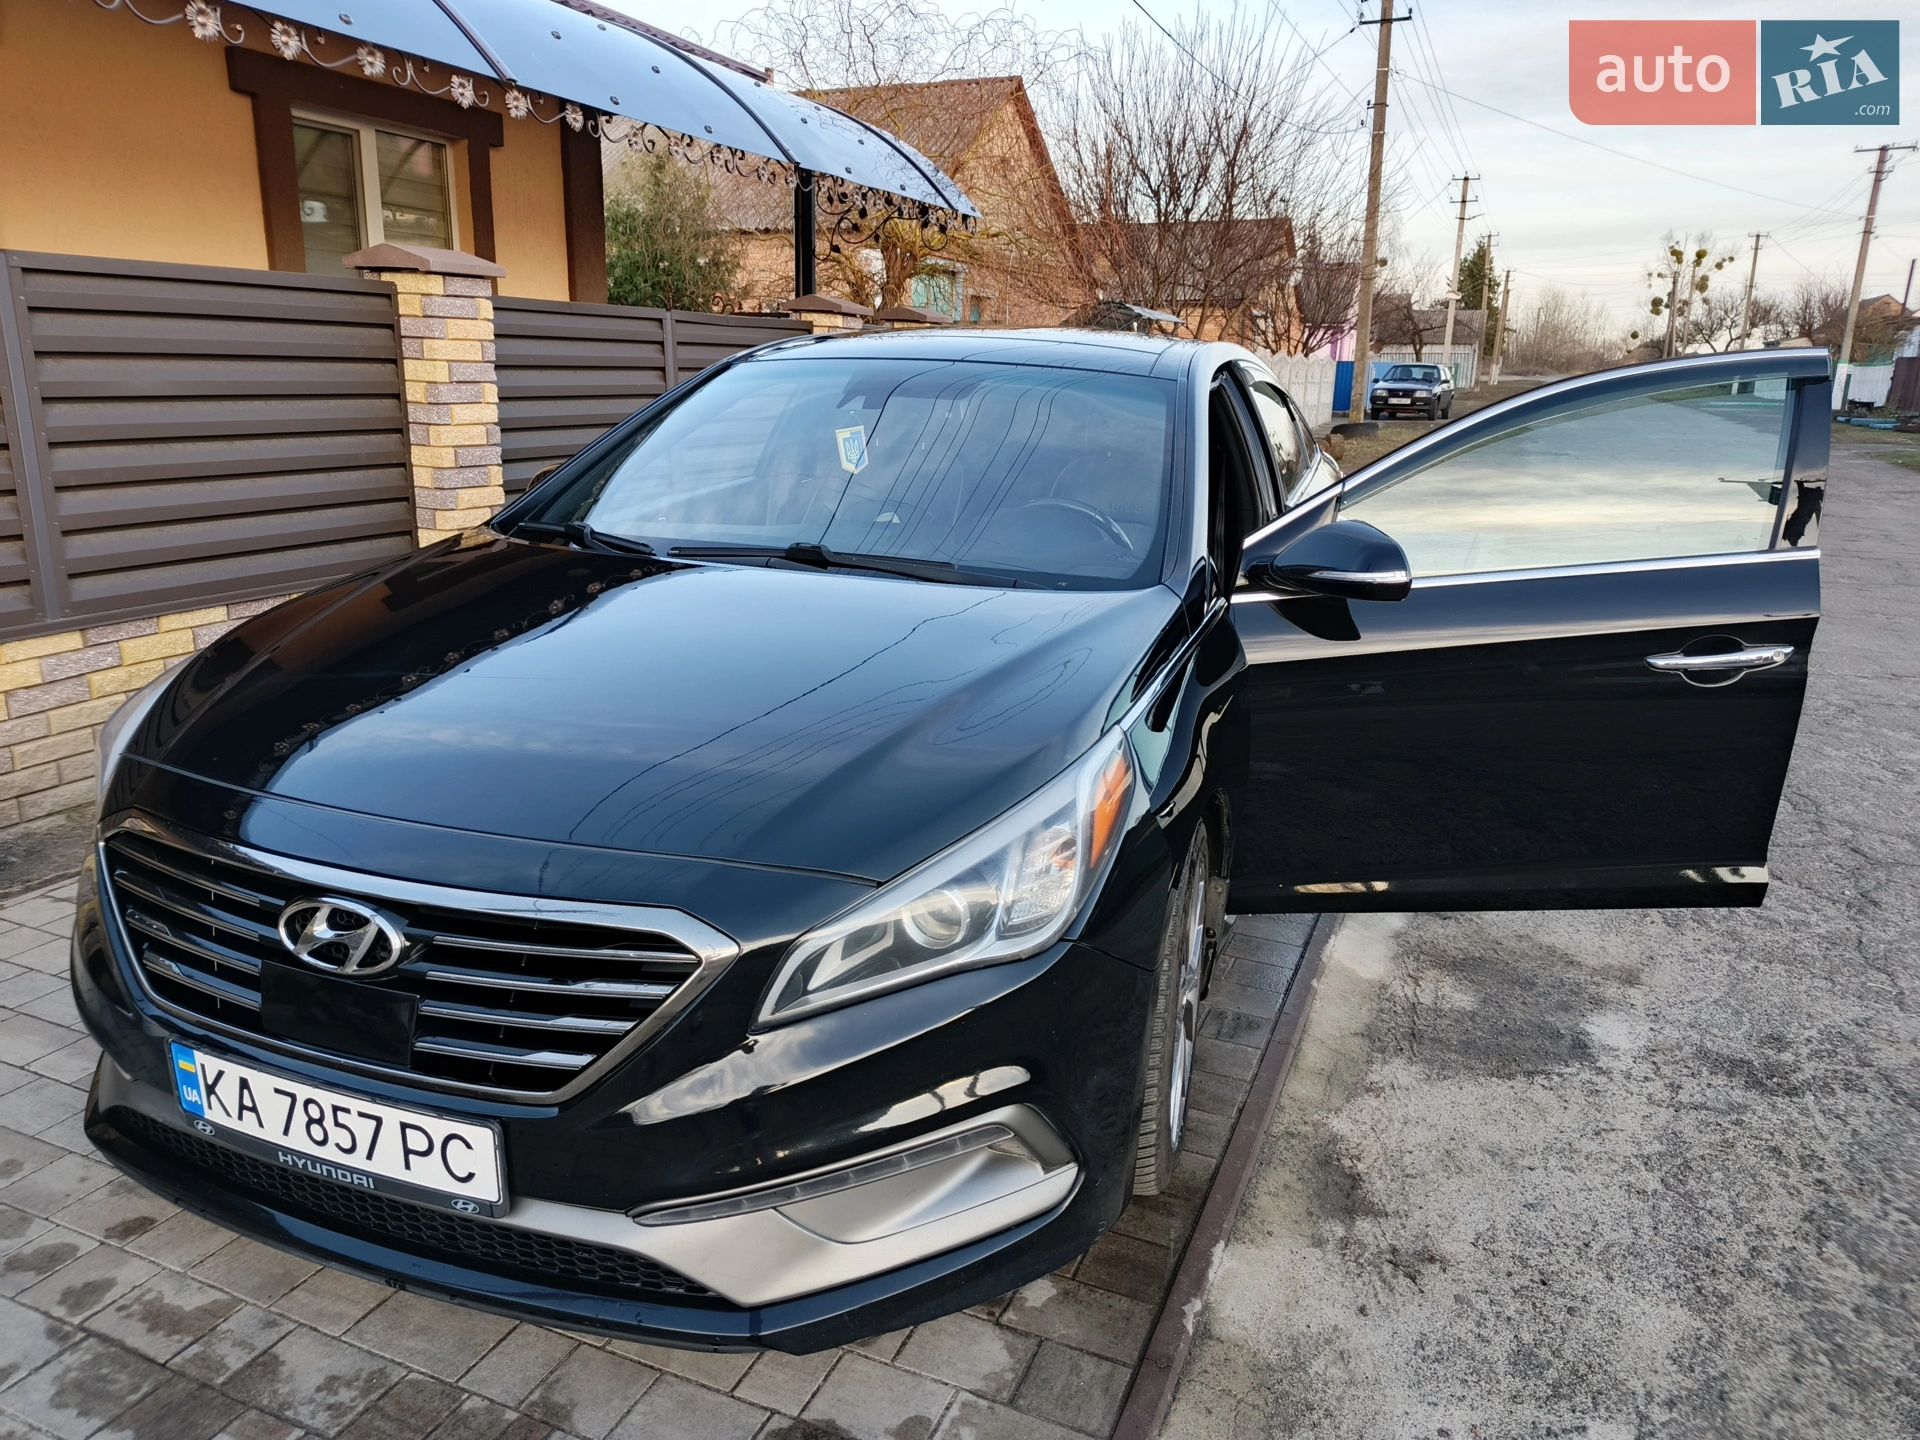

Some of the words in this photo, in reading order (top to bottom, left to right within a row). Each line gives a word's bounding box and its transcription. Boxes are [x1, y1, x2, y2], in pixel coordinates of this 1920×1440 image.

[183, 1087, 200, 1104] UA
[200, 1062, 264, 1129] KA
[273, 1088, 383, 1161] 7857
[399, 1121, 476, 1184] PC
[278, 1151, 375, 1189] HYUNDAI
